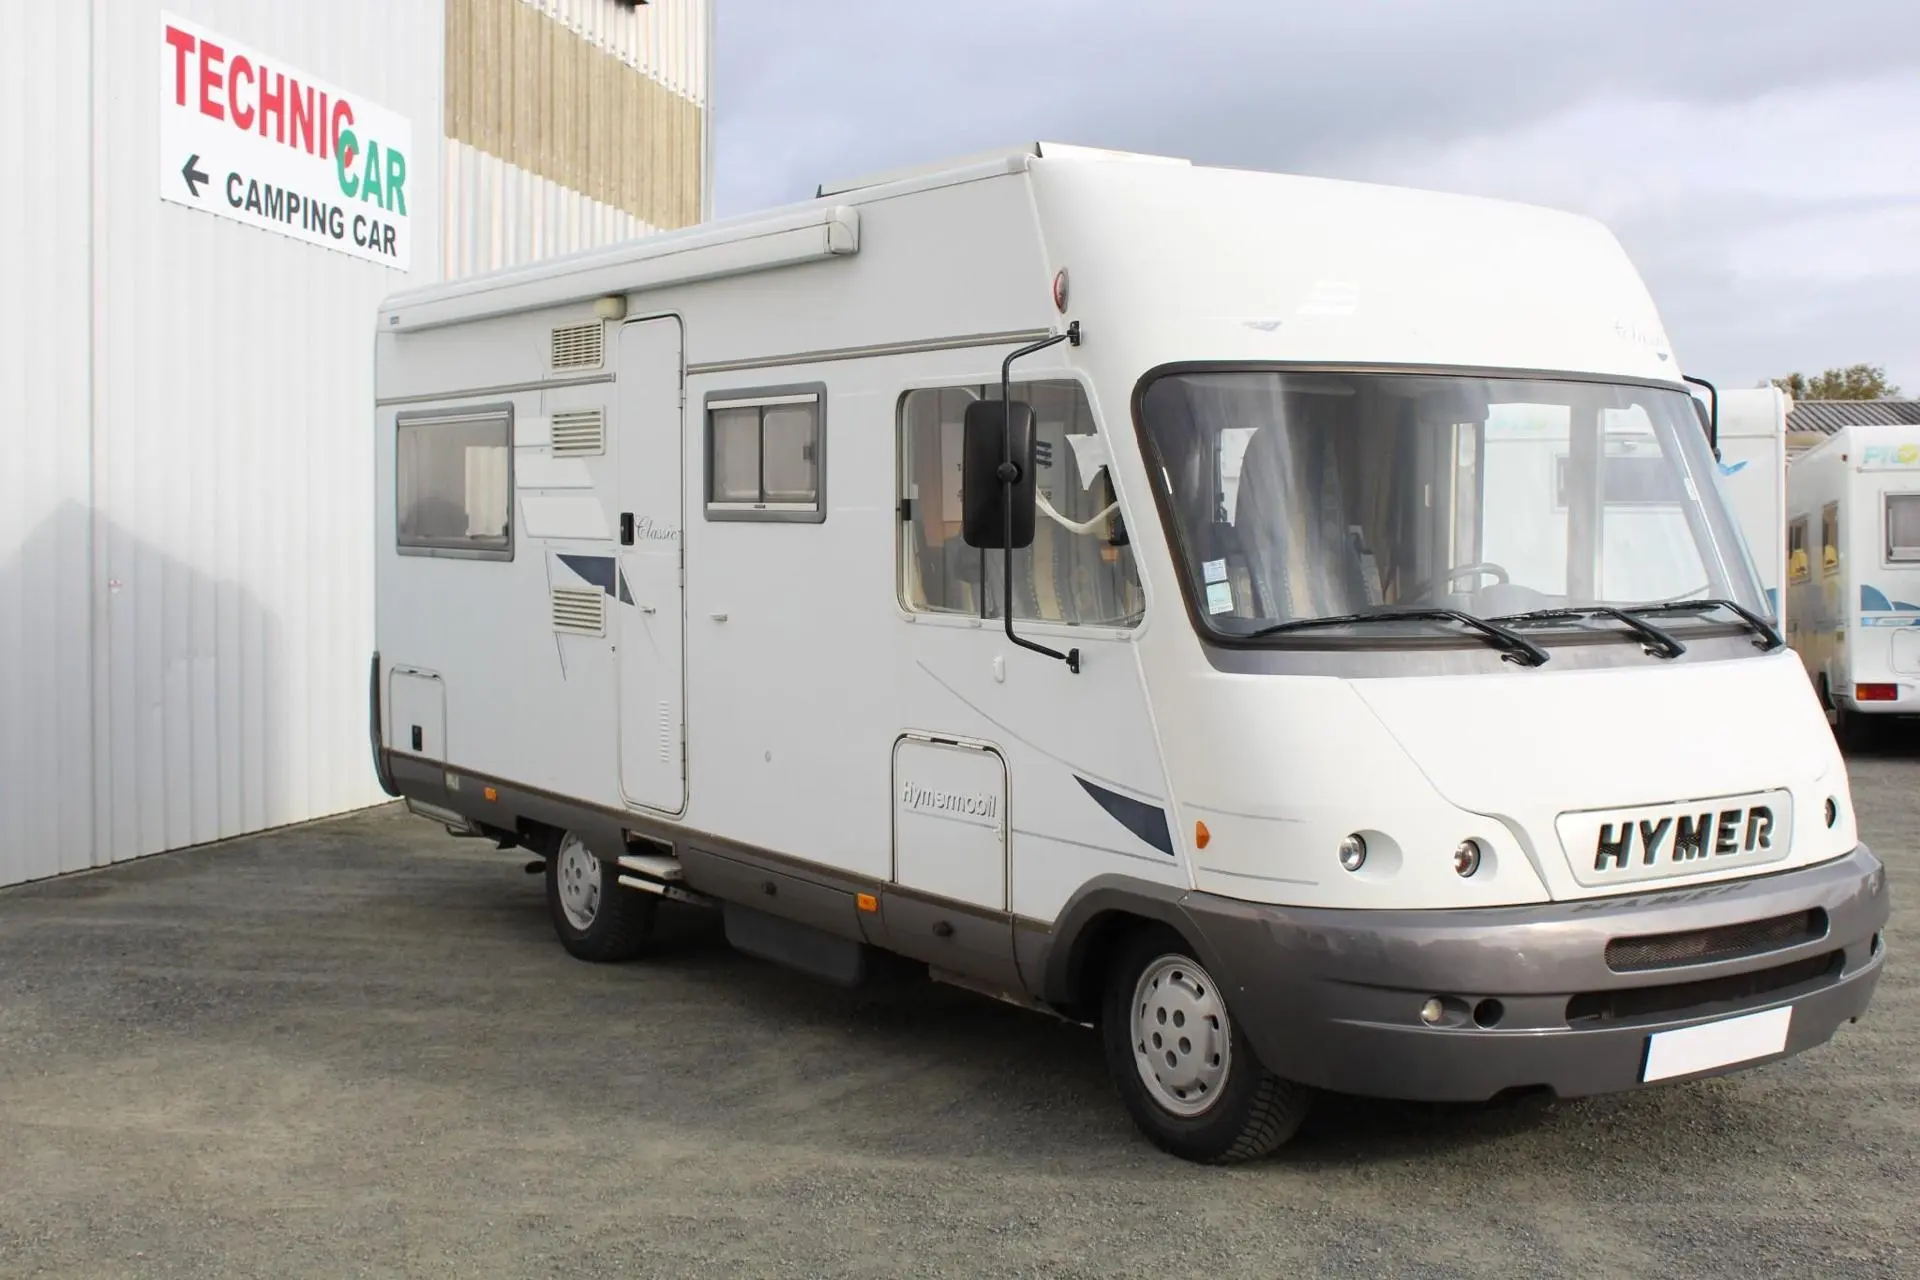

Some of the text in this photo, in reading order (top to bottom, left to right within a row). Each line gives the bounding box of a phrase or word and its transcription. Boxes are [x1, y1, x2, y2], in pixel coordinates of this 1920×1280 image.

[226, 172, 397, 257] CAMPING CAR
[337, 129, 407, 217] CAR
[1594, 805, 1774, 871] HYMER
